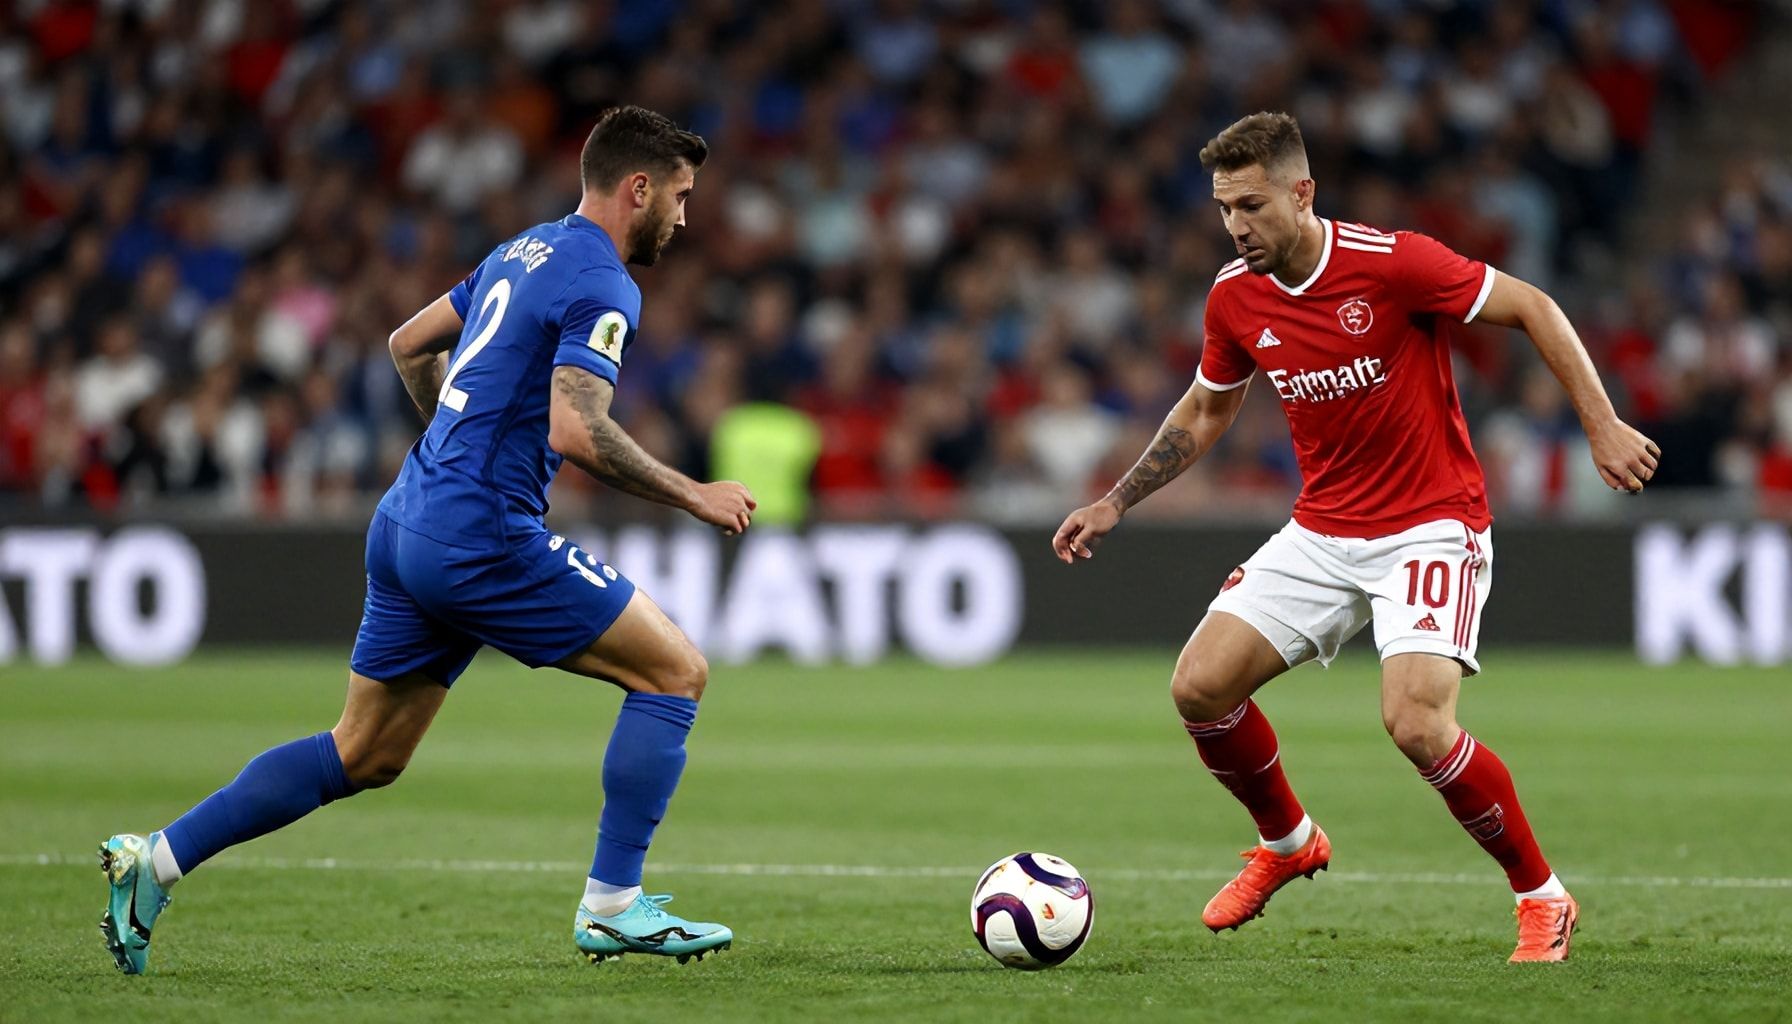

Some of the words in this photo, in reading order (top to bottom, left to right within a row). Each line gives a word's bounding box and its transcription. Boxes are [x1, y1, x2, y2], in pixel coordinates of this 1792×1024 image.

[439, 278, 512, 413] 2
[0, 524, 207, 668] TO
[580, 524, 1024, 669] HATO
[1403, 559, 1450, 609] 10
